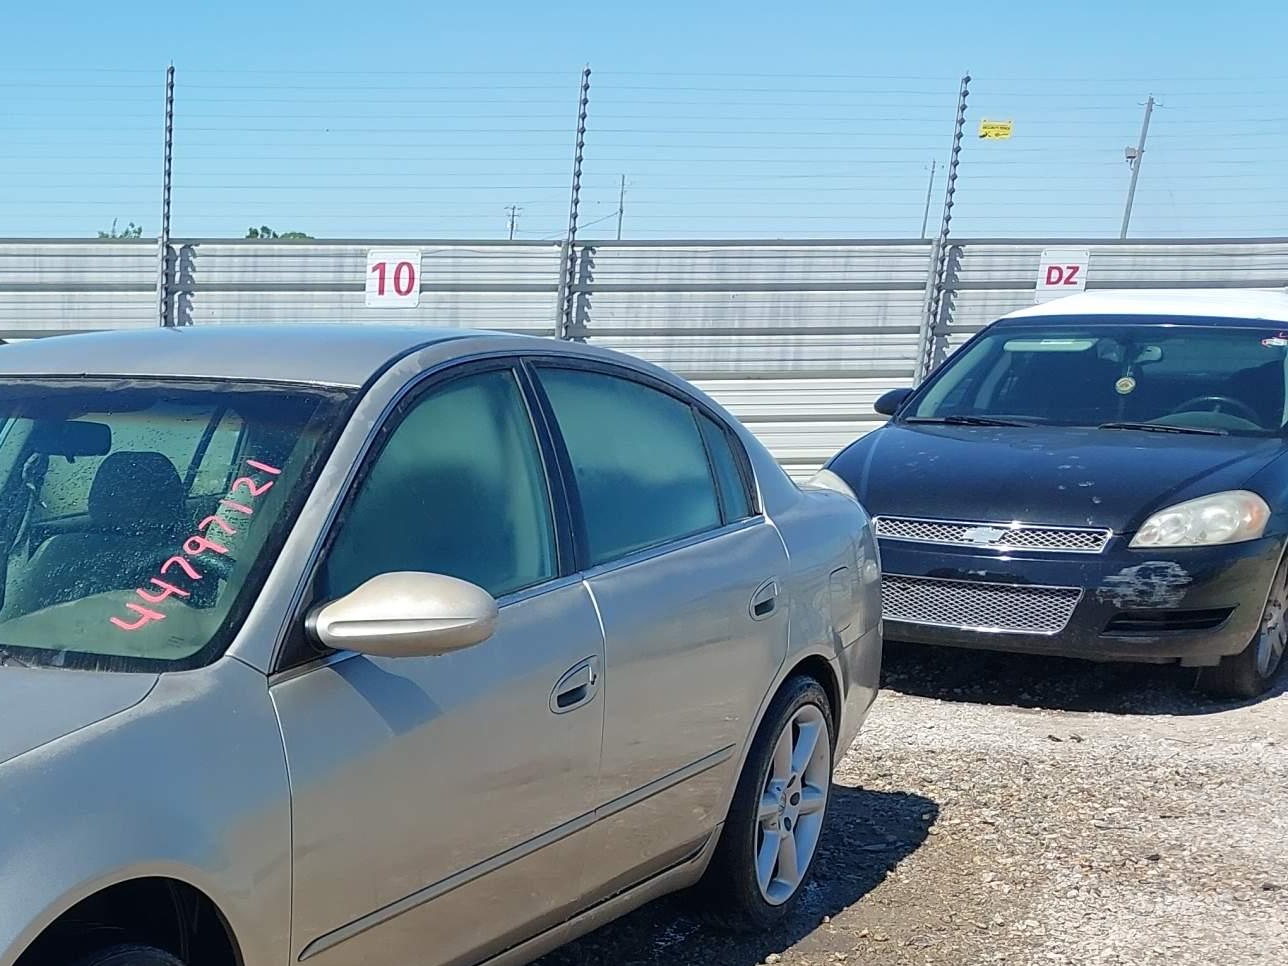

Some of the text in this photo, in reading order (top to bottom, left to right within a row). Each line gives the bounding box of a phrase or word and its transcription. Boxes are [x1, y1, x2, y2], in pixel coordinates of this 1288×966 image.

[372, 261, 415, 296] 10
[1046, 265, 1080, 285] DZ
[110, 459, 282, 630] 44797121
